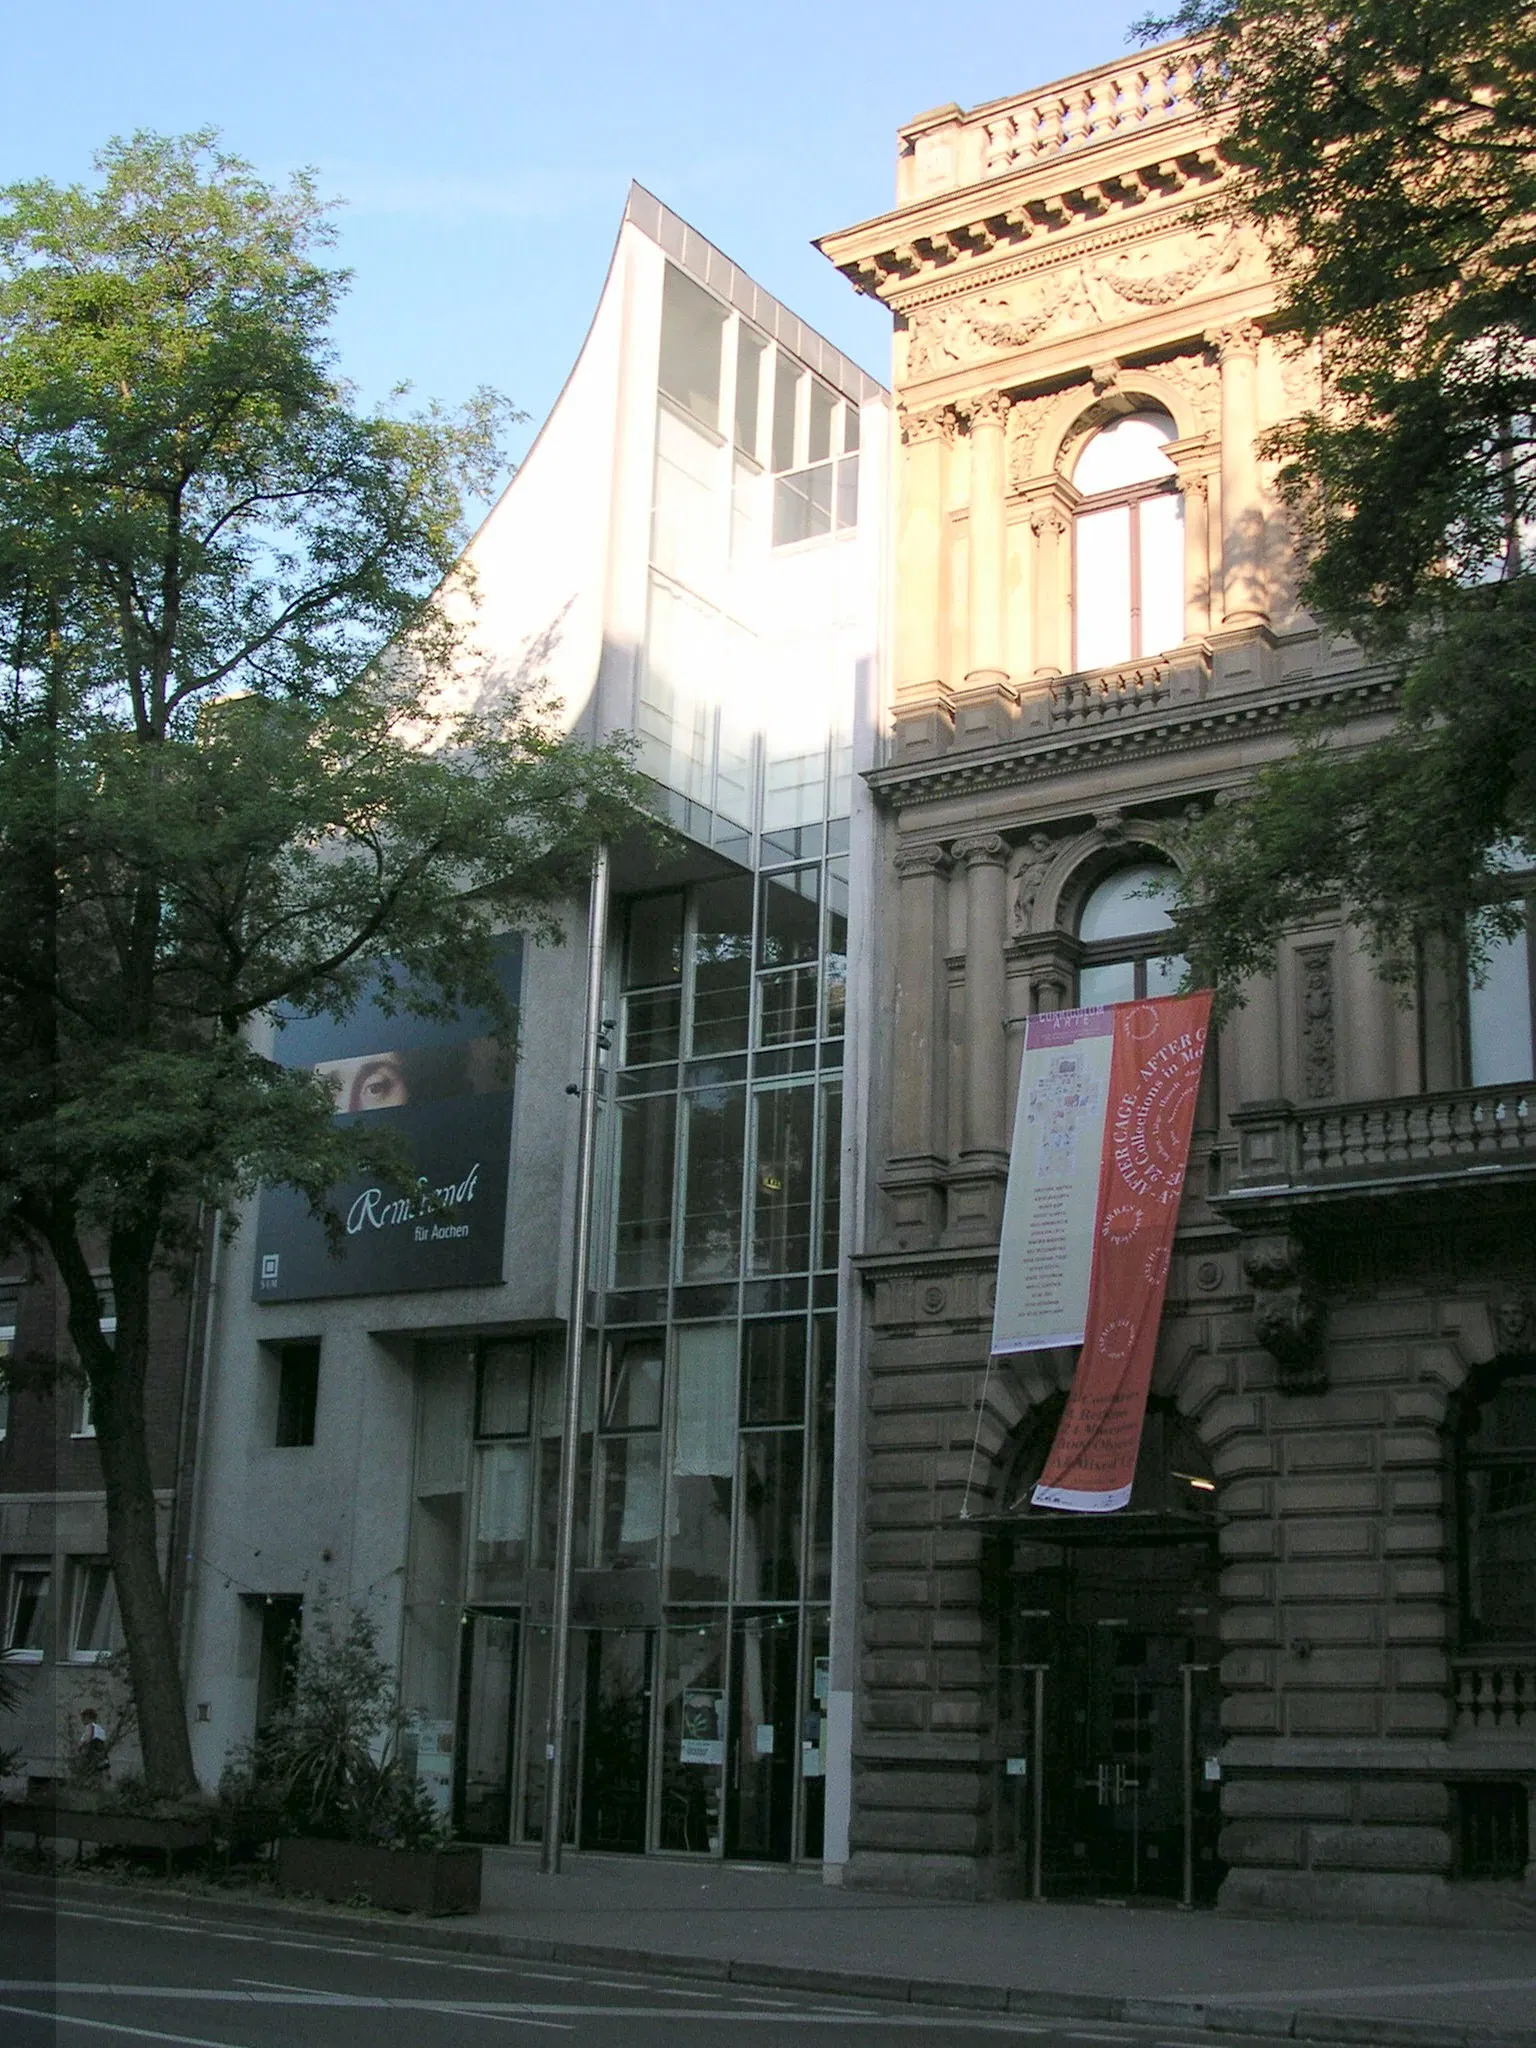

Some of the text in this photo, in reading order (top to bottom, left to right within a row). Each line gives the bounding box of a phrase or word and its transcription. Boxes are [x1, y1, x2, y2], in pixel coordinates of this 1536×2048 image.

[1139, 1033, 1192, 1082] AFTER
[1113, 1093, 1137, 1144] CAGE
[1131, 1080, 1164, 1166] Collections
[1161, 1063, 1179, 1079] in
[1114, 1147, 1150, 1195] AFTER
[347, 1163, 480, 1234] Remndt
[414, 1223, 469, 1241] für Aachen
